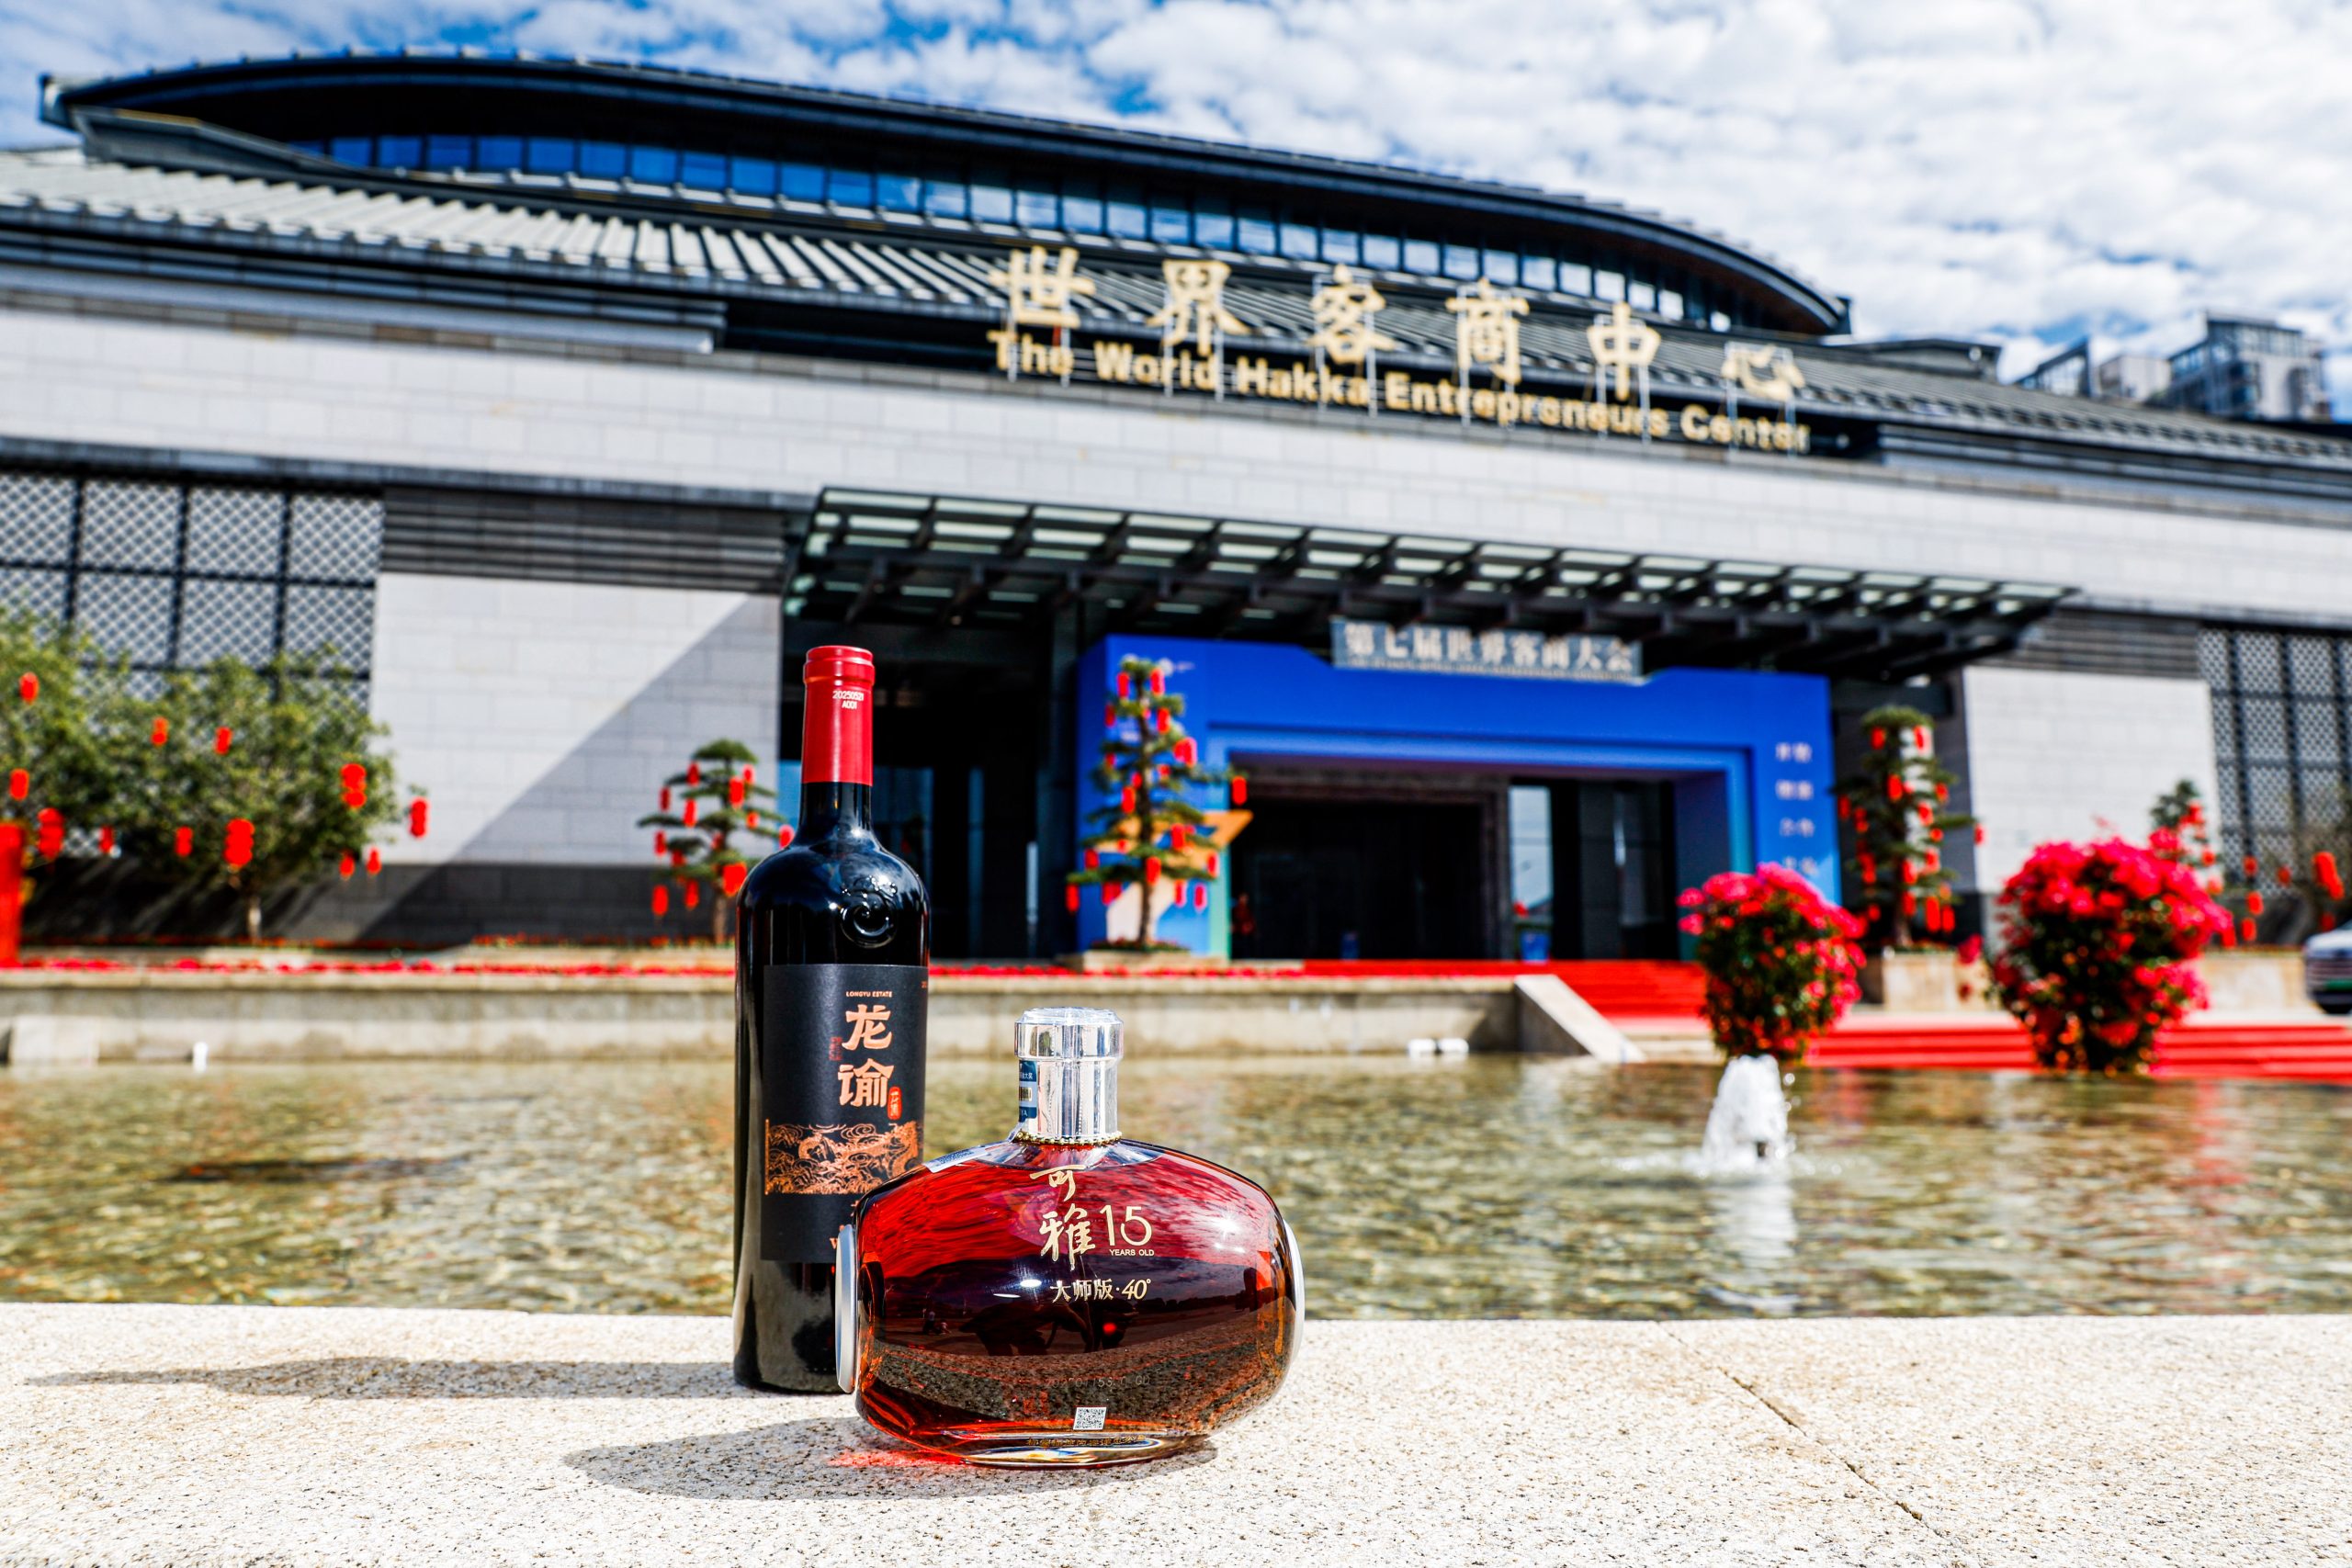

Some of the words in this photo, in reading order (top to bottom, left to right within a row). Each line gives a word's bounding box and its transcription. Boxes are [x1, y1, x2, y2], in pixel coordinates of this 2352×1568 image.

[988, 245, 1804, 402] 世界客商中心
[987, 330, 1074, 375] The
[1093, 340, 1217, 391] World
[1237, 355, 1369, 407] Hakka
[1385, 370, 1670, 439] Entrepreneurs
[1680, 404, 1811, 453] Center
[1343, 623, 1634, 672] 第七届世界客商大会
[837, 1003, 895, 1108] 龙谕
[1029, 1164, 1096, 1271] 可雅
[1099, 1204, 1153, 1247] 15
[1109, 1248, 1136, 1257] YEARS
[1138, 1248, 1155, 1257] OLD
